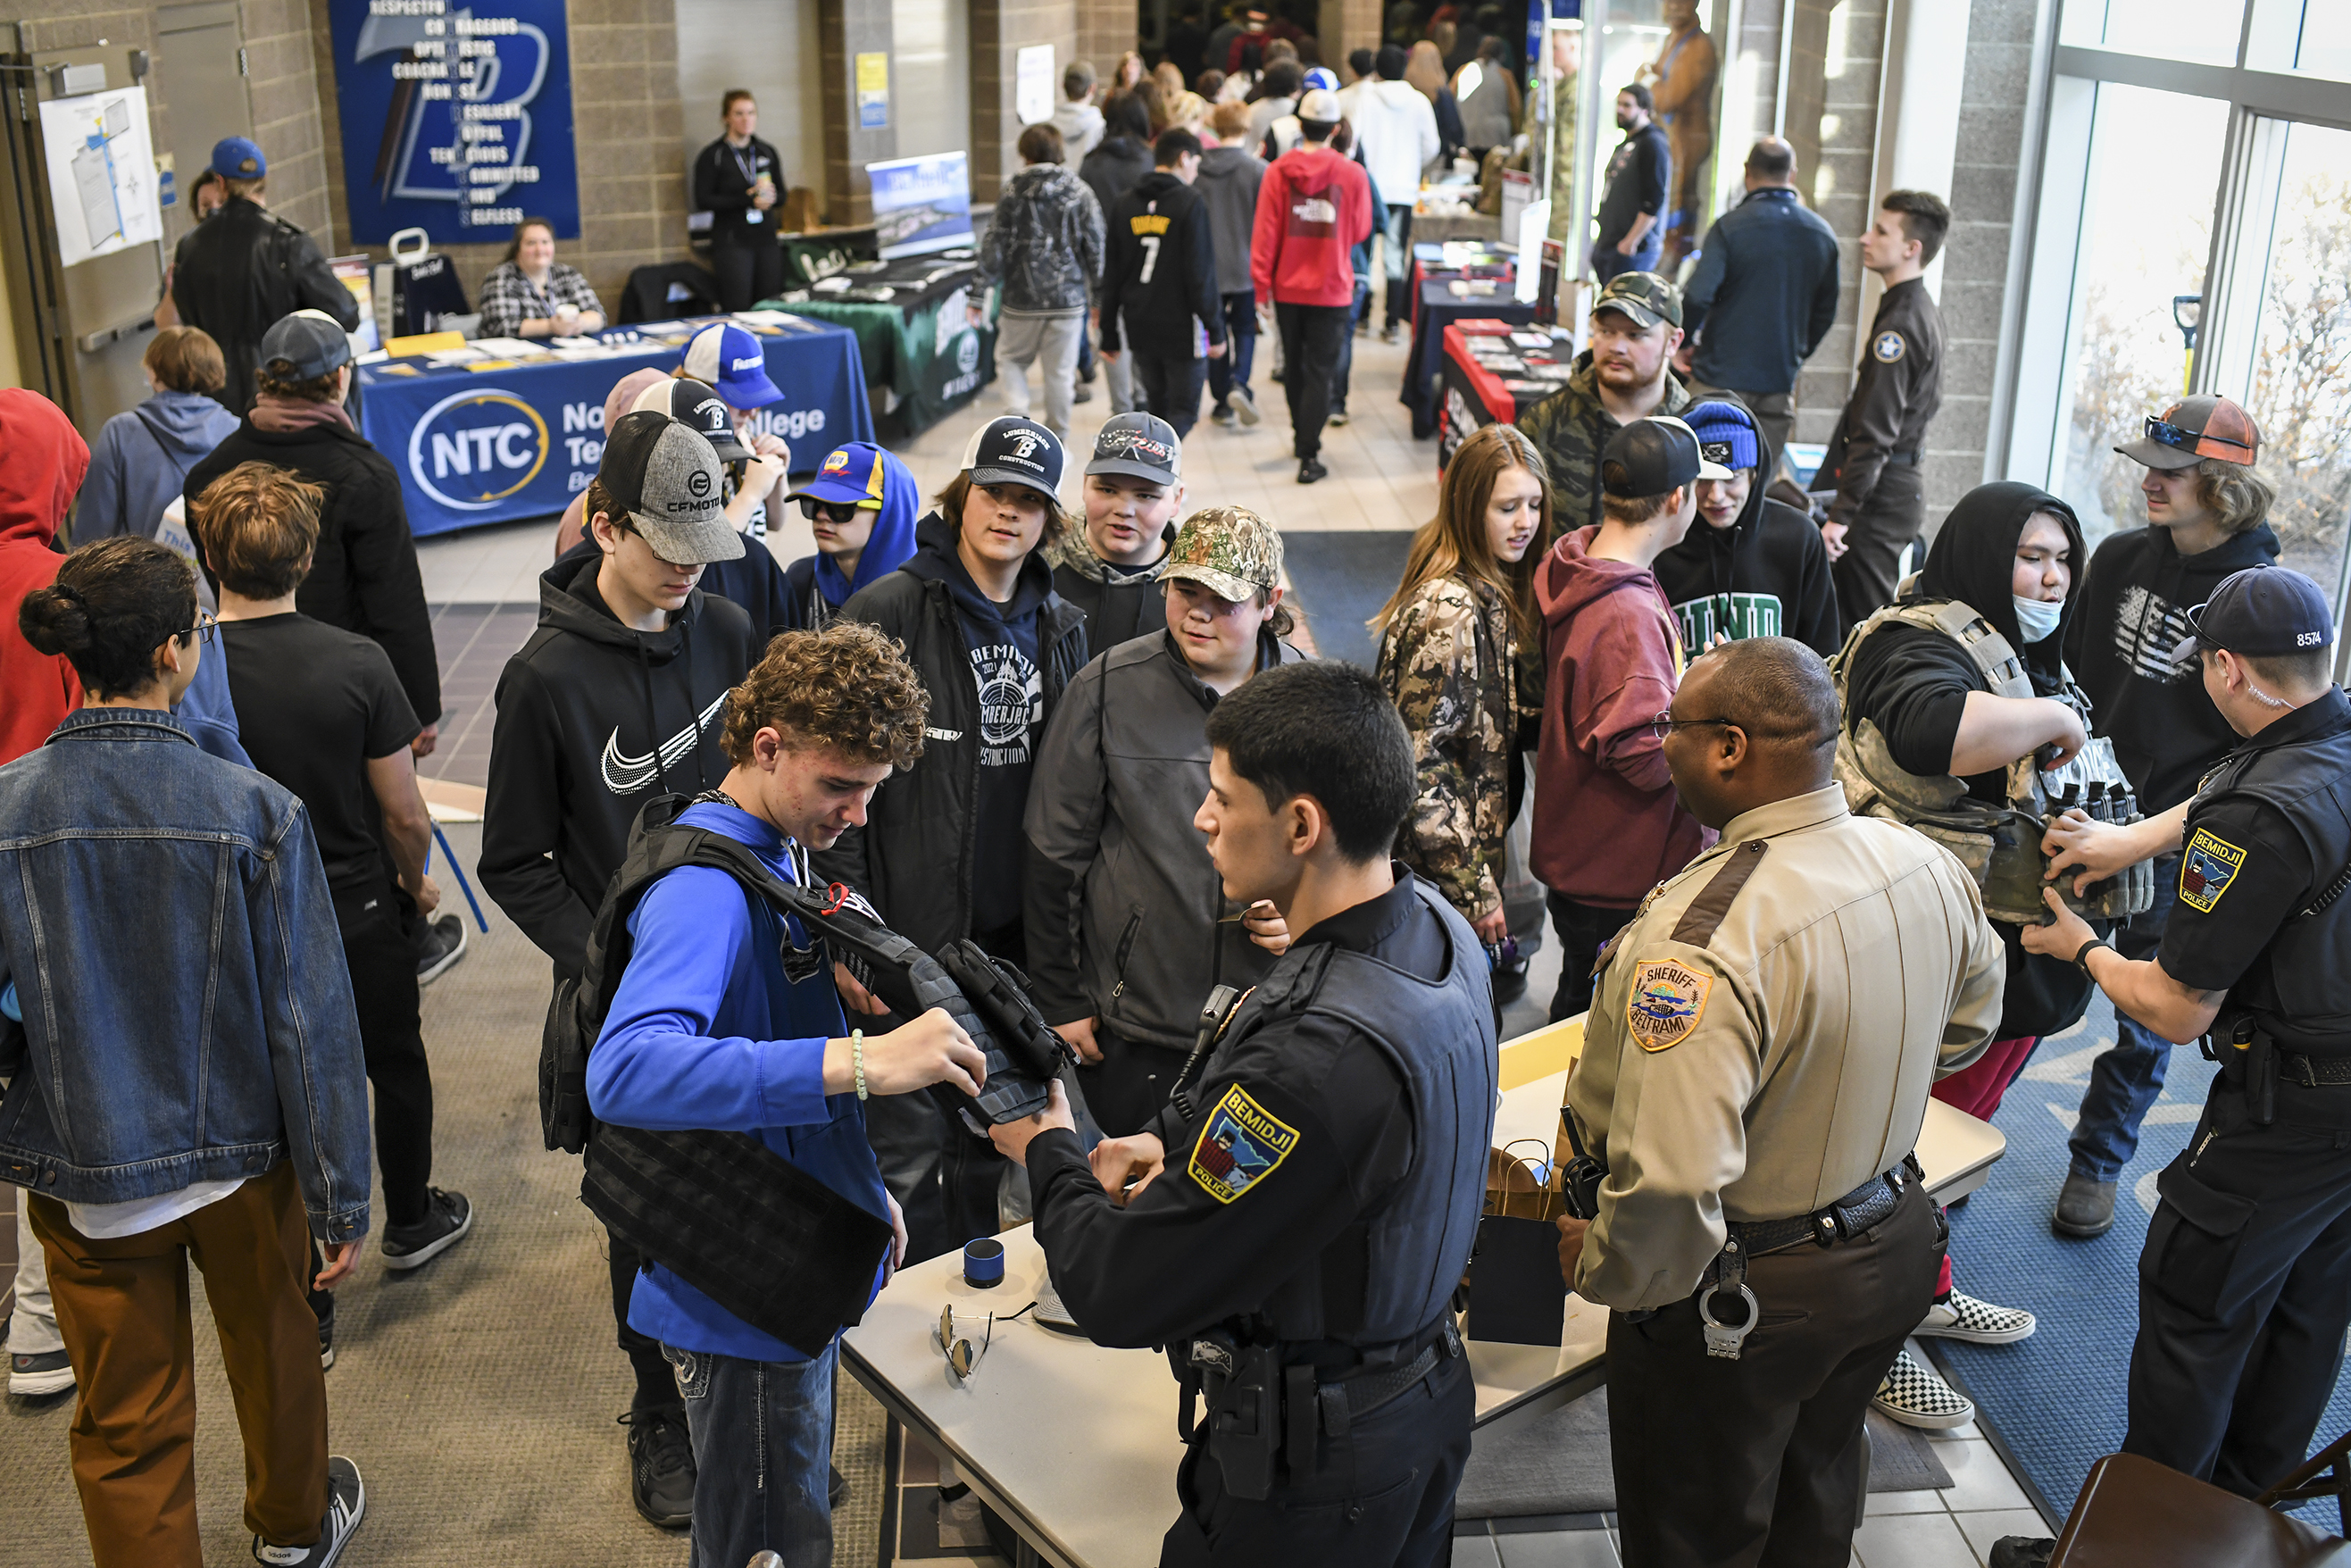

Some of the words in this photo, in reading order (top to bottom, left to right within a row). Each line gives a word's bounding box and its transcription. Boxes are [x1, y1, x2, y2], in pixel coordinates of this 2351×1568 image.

[1139, 237, 1160, 283] 7
[431, 422, 533, 479] NTC
[1003, 429, 1051, 451] LUMBERJACK
[998, 455, 1046, 473] CONSTRUCTION
[667, 496, 720, 512] CFMOTO
[2297, 631, 2322, 646] 8574
[980, 705, 1030, 725] MBERJAC
[980, 746, 1026, 766] STRUCTION
[2196, 833, 2241, 863] BEMIDJI
[2183, 890, 2208, 908] POLICE
[1647, 967, 1697, 988] SHERIFF
[1631, 1008, 1686, 1033] BELTRAMI
[1228, 1093, 1291, 1149] BEMIDJI
[1195, 1167, 1231, 1197] POLICE
